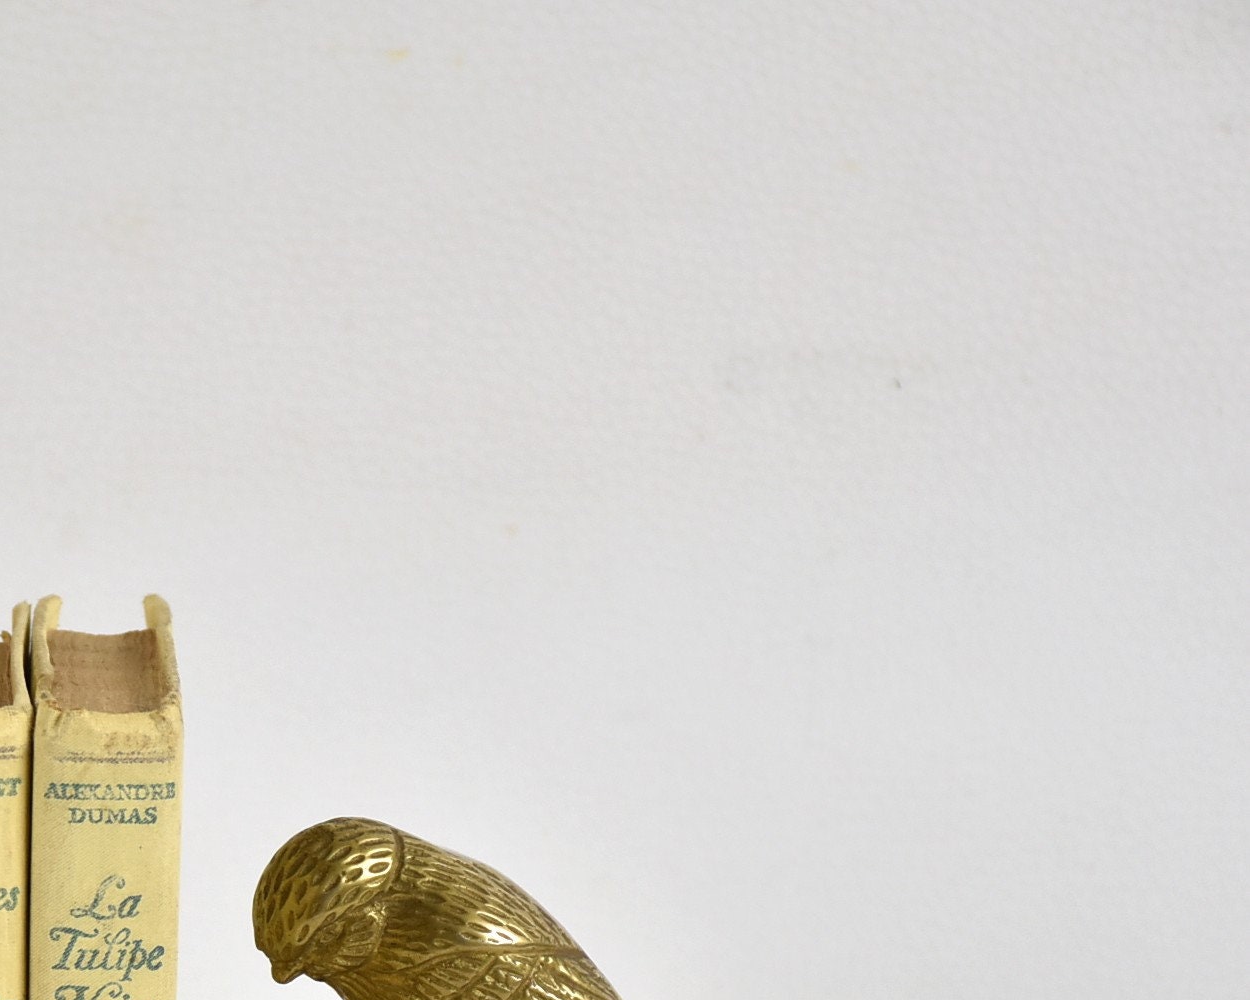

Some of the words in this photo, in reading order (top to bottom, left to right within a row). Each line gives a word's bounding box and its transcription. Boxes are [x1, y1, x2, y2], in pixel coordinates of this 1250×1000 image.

[44, 781, 176, 801] ALEXANDRE
[68, 807, 158, 825] DUMAS
[70, 873, 142, 921] La
[50, 926, 165, 982] Tulipe
